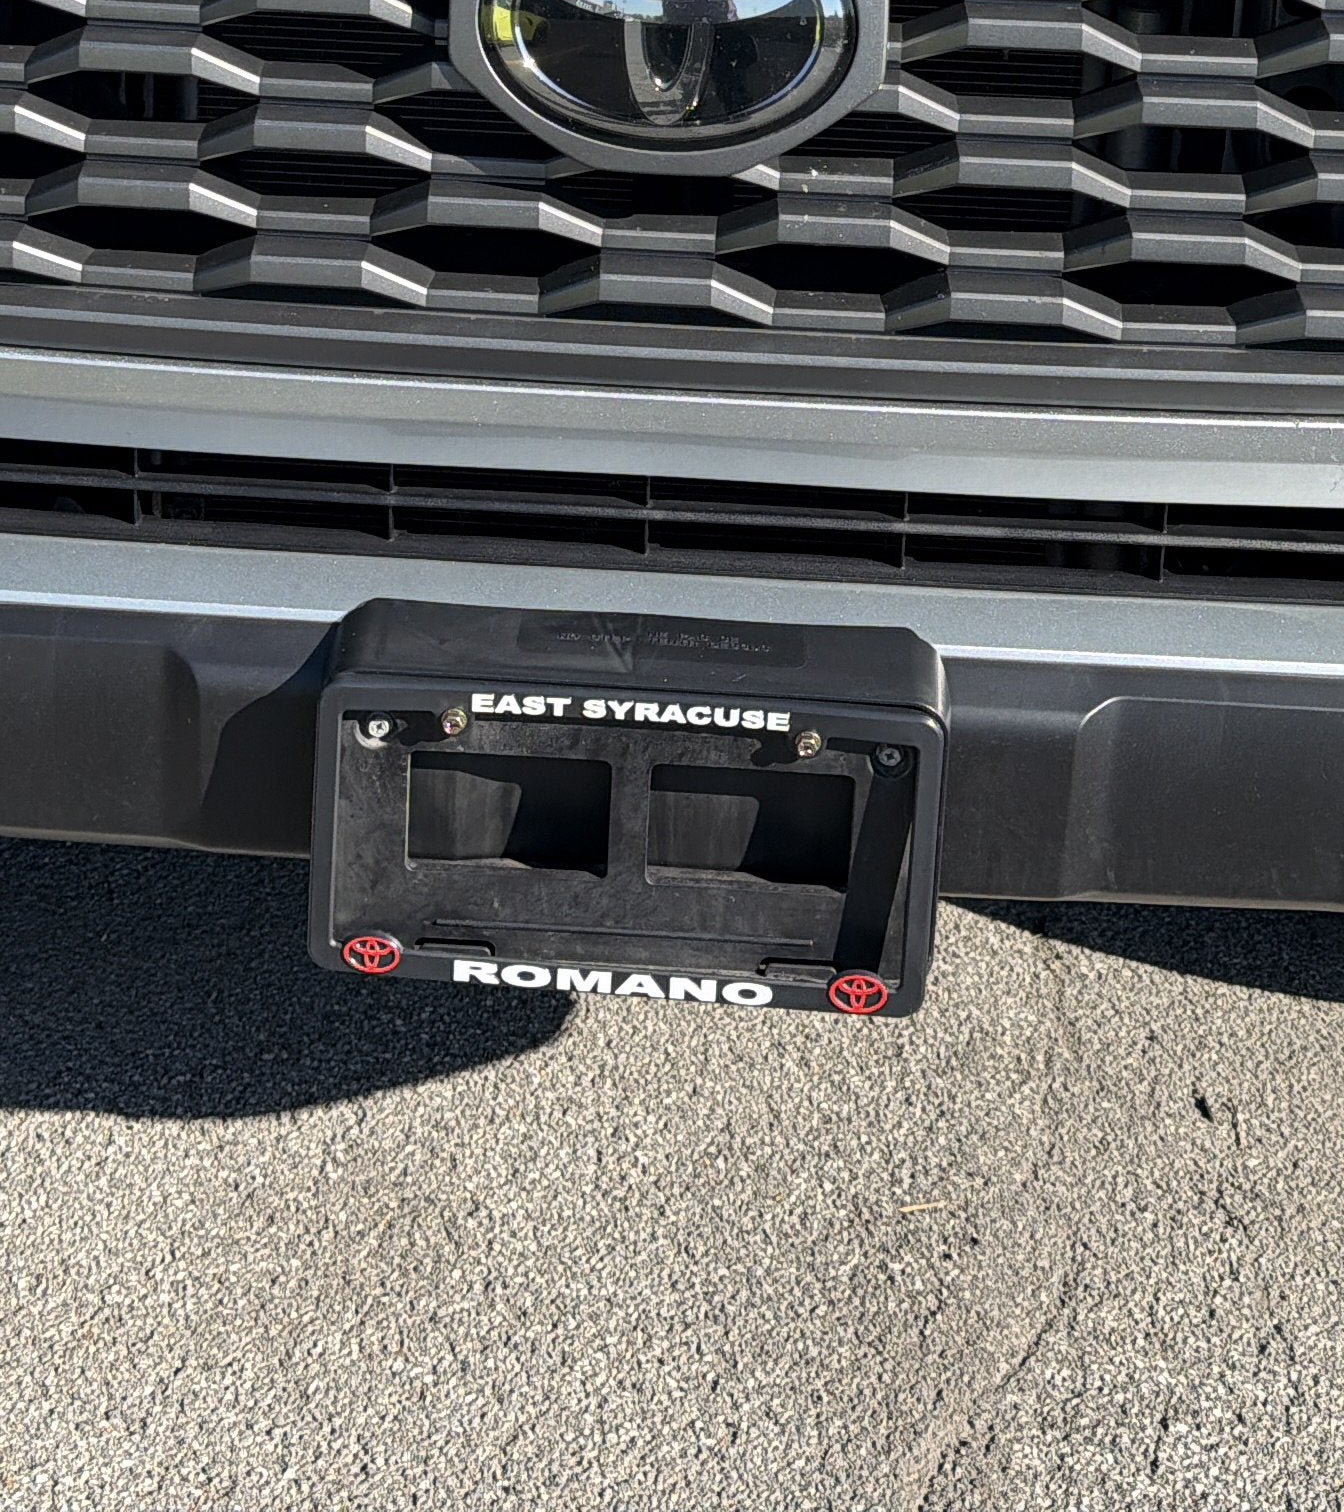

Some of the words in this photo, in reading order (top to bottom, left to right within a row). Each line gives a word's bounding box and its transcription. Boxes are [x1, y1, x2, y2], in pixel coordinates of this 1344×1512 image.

[470, 693, 573, 717] EAST
[582, 698, 791, 733] SYRACUSE
[452, 959, 775, 1006] ROMANO
